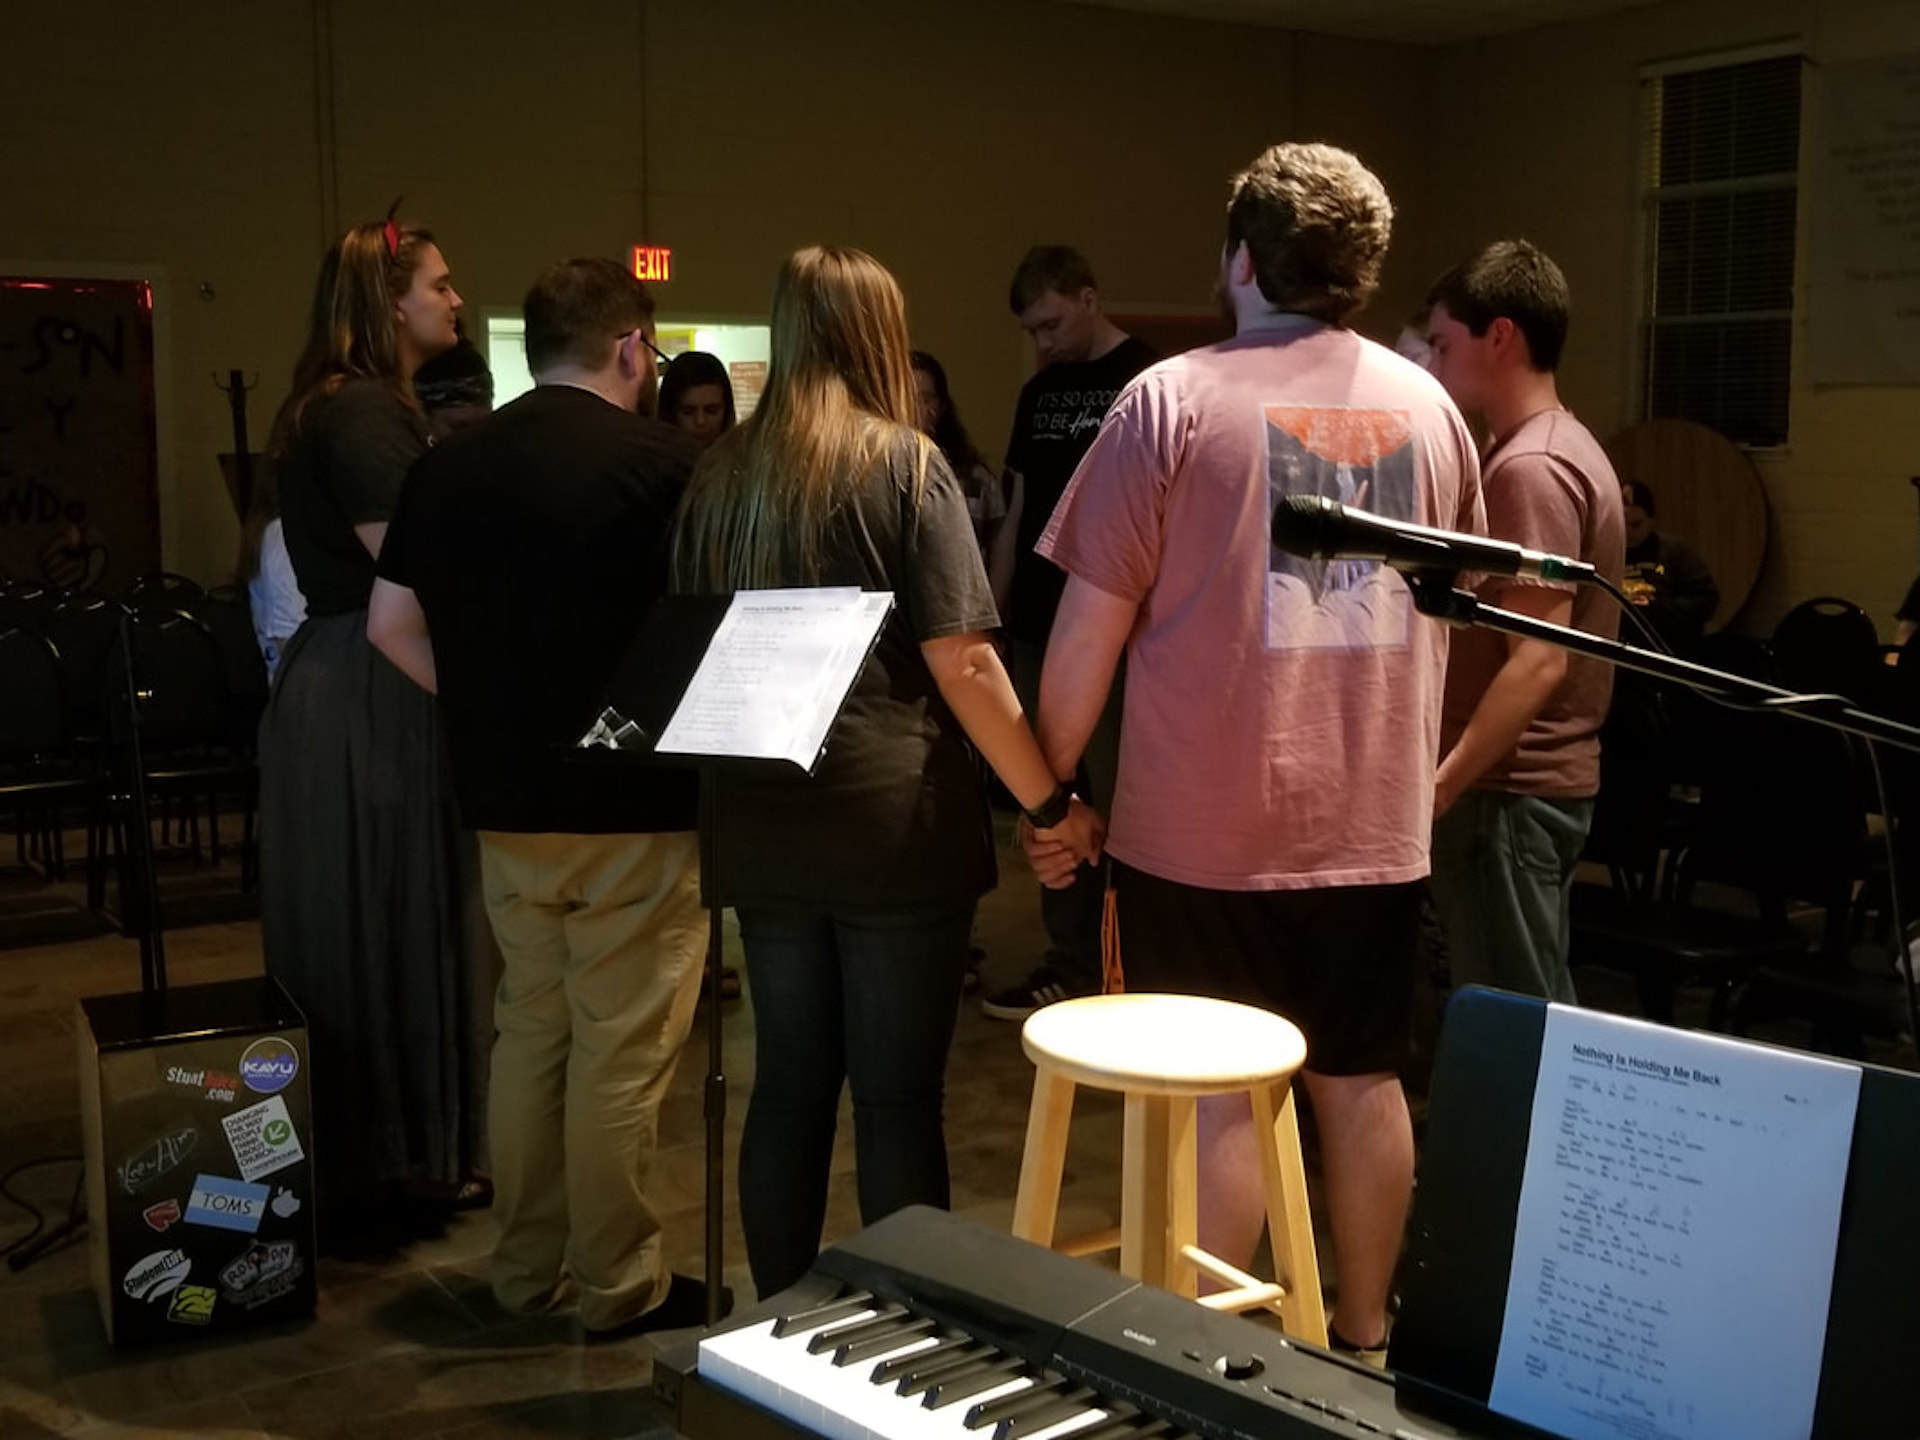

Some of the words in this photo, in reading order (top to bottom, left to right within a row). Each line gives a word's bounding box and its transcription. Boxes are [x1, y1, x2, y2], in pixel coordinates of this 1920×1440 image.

[635, 247, 670, 281] EXIT
[244, 1062, 294, 1075] KAVU
[1572, 1044, 1614, 1065] Nothing
[1628, 1055, 1671, 1077] Holding
[1673, 1065, 1690, 1079] Me
[1692, 1069, 1721, 1086] Back
[203, 1192, 252, 1215] TOMS
